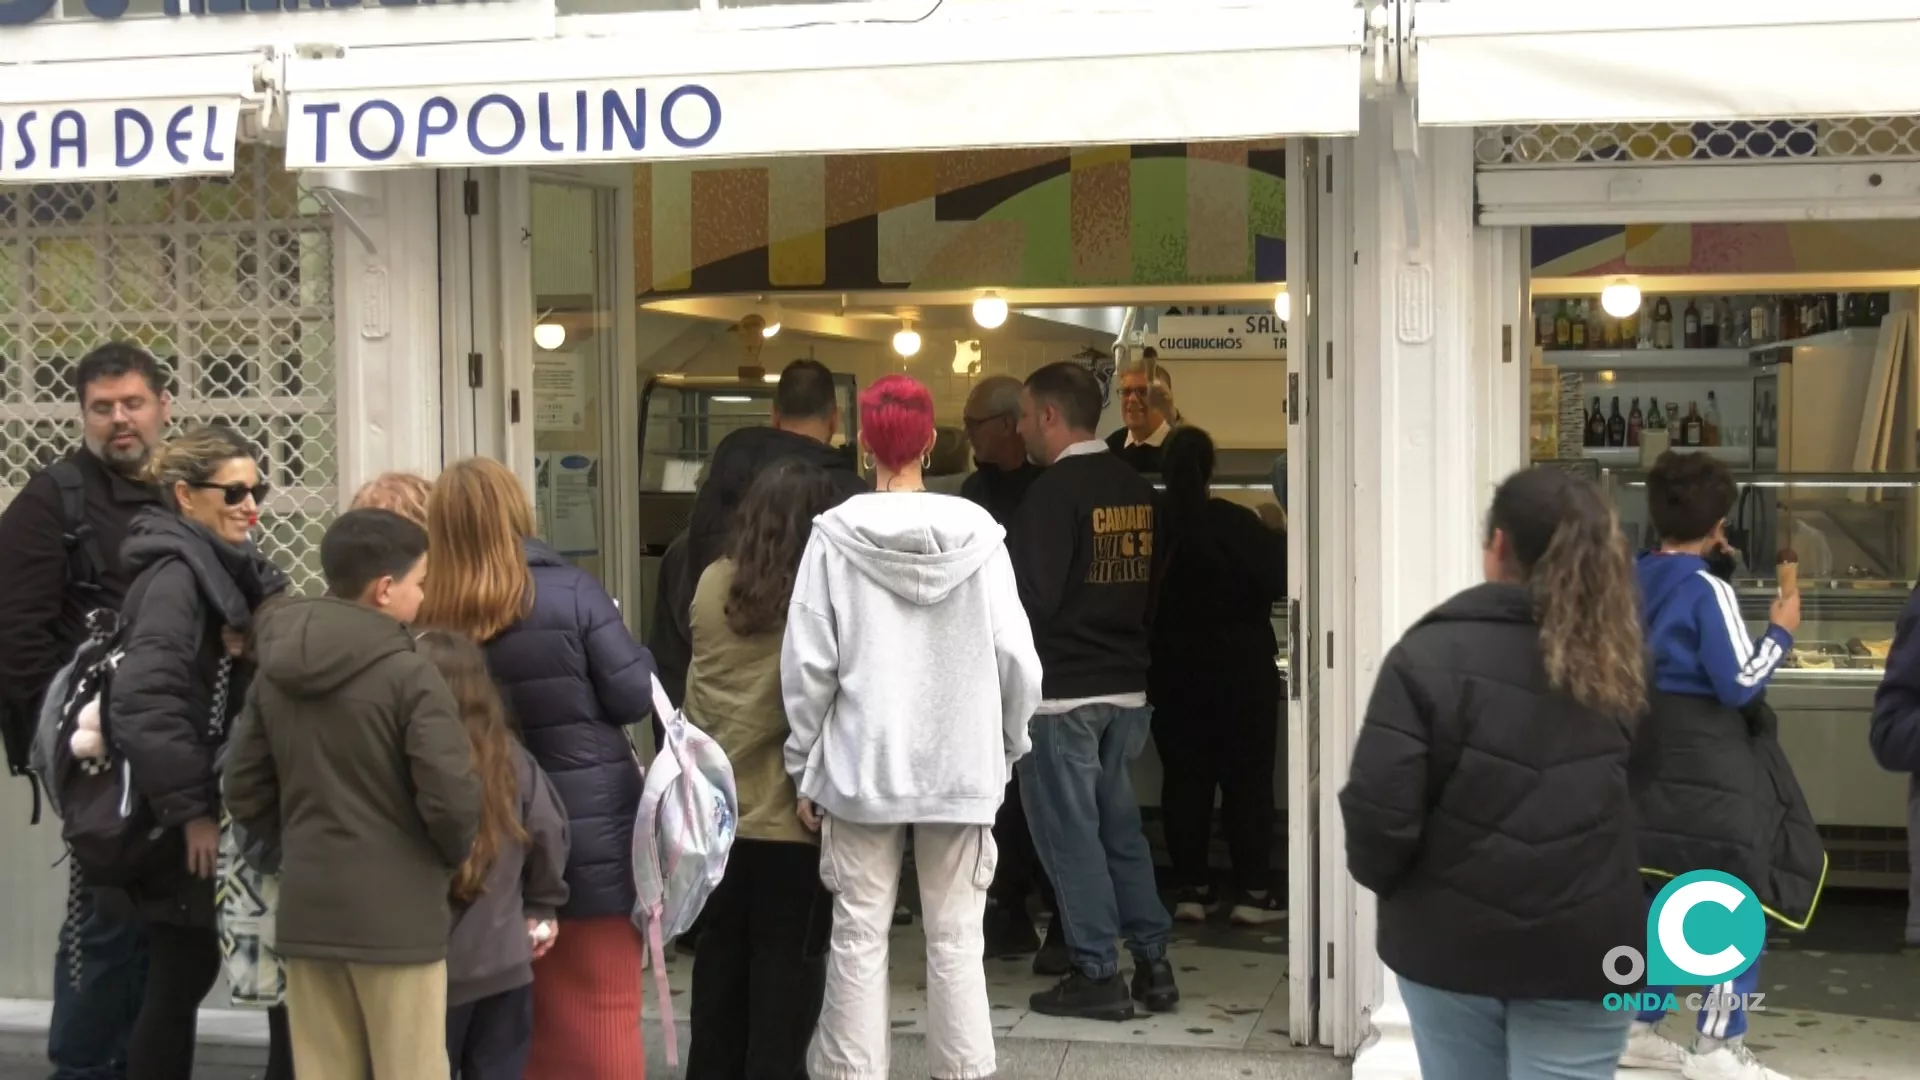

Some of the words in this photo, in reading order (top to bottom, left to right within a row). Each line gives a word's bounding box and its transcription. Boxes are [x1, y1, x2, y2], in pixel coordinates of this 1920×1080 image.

[0, 109, 87, 170] SA
[114, 105, 224, 168] DEL
[303, 84, 722, 164] TOPOLINO
[1159, 338, 1243, 349] CUCURUCHOS
